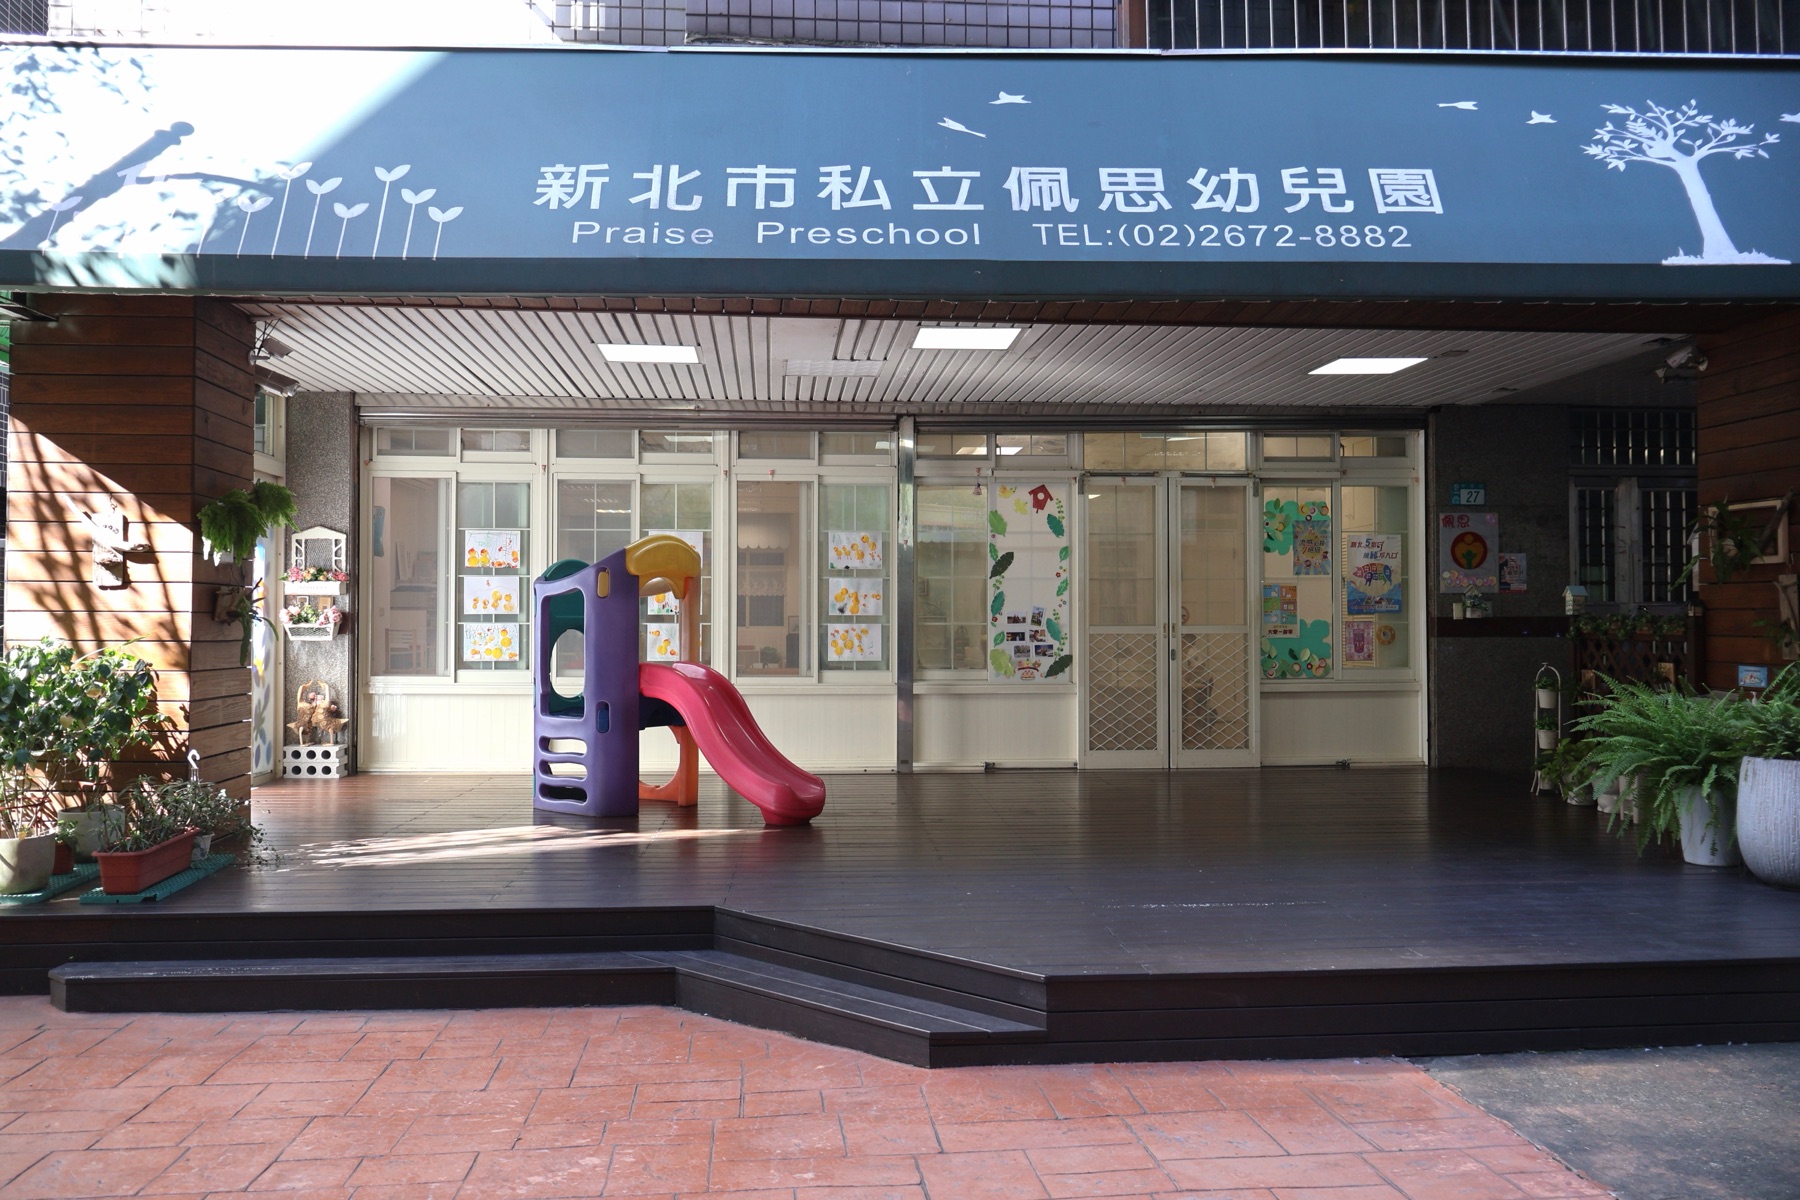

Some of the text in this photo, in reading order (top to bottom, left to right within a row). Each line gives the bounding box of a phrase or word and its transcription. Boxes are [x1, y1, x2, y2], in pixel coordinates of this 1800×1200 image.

[533, 163, 1444, 214] 新北市私立佩思幼兒園
[572, 221, 980, 246] Praise Preschool
[1032, 223, 1412, 248] TEL:(02)2672-8882
[1466, 490, 1480, 503] 27
[1441, 514, 1470, 528] 佩思
